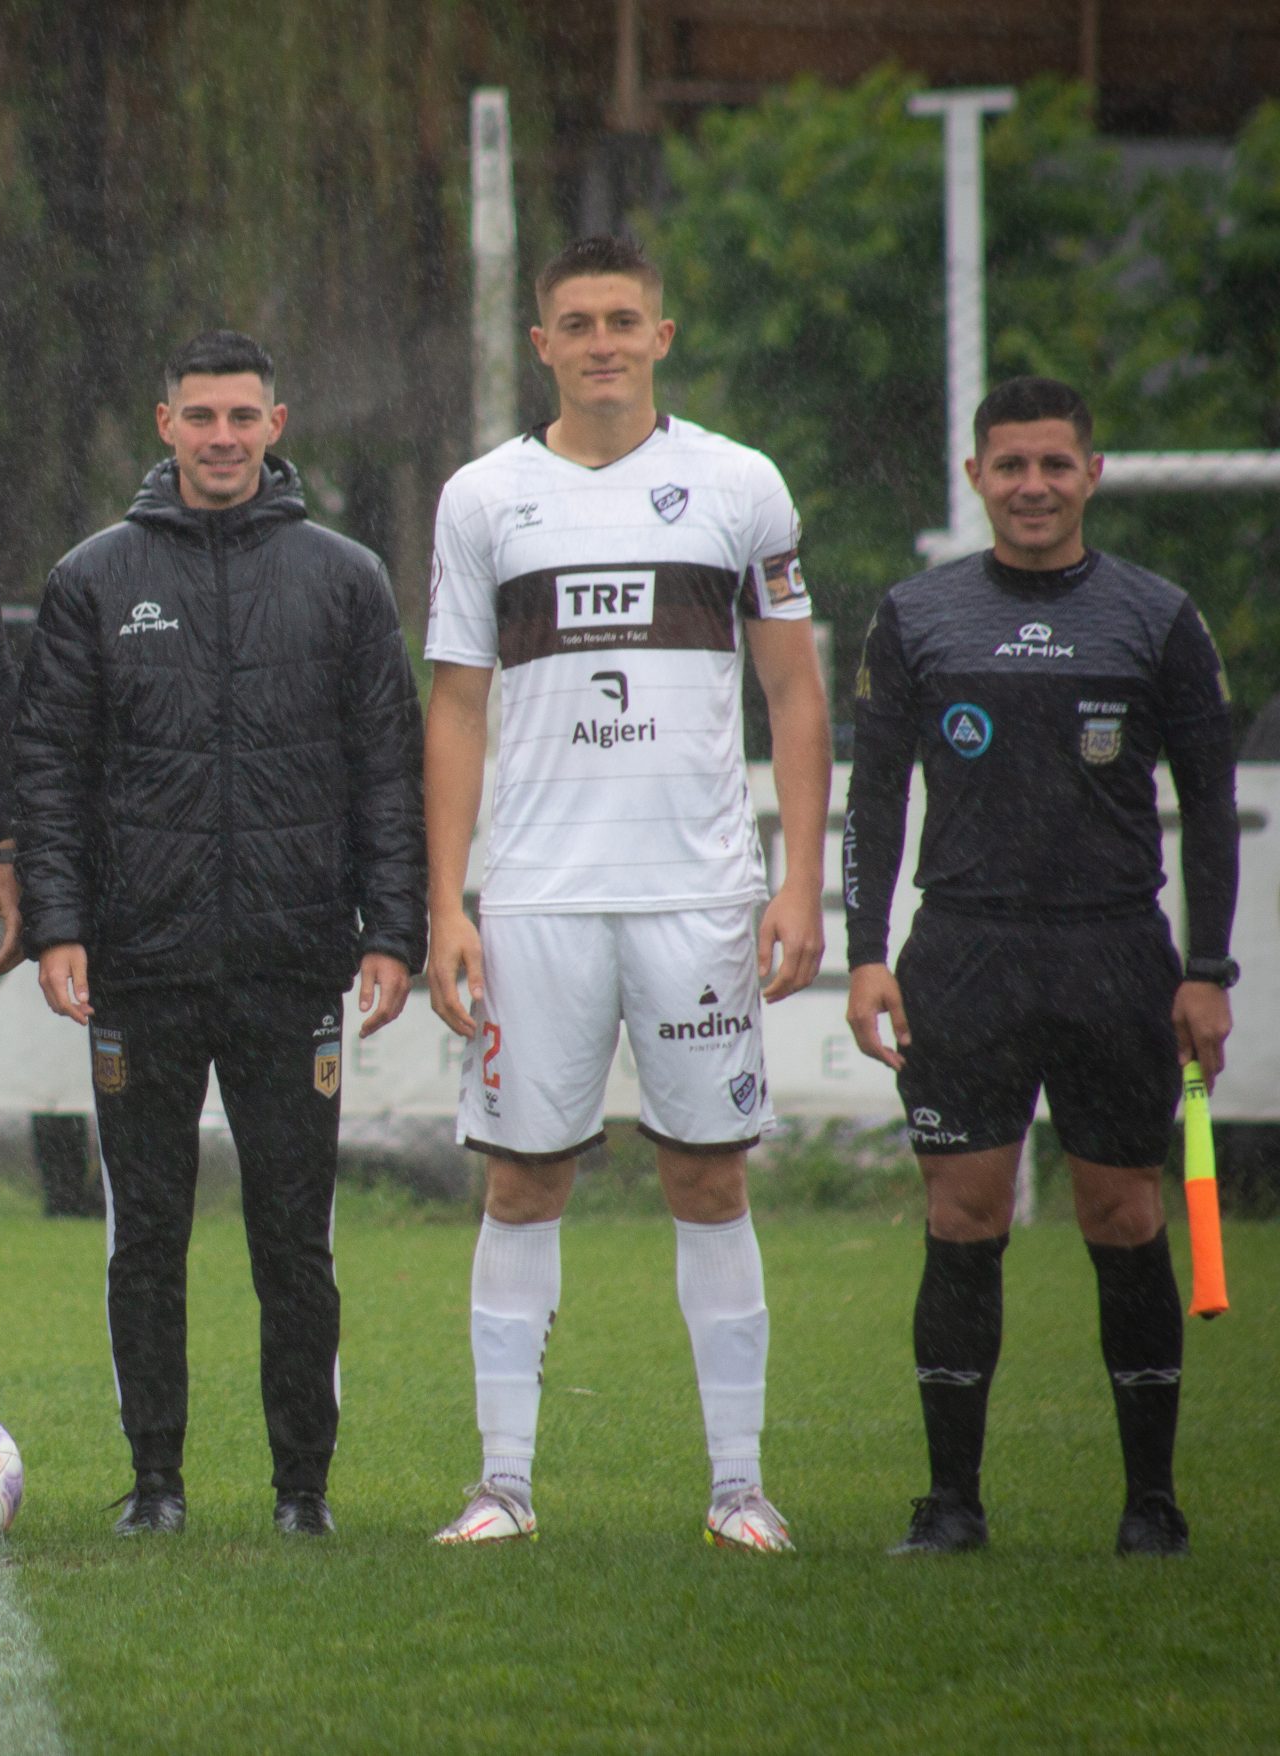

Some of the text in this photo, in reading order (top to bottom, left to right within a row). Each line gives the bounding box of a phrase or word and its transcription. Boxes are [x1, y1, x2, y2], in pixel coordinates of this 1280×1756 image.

[565, 582, 645, 616] TRF
[119, 618, 178, 636] ATHIX
[995, 643, 1073, 657] ATHIX
[571, 718, 656, 748] Algieri
[844, 809, 860, 909] ATHIX
[658, 1012, 753, 1041] andina
[482, 1021, 501, 1089] 2
